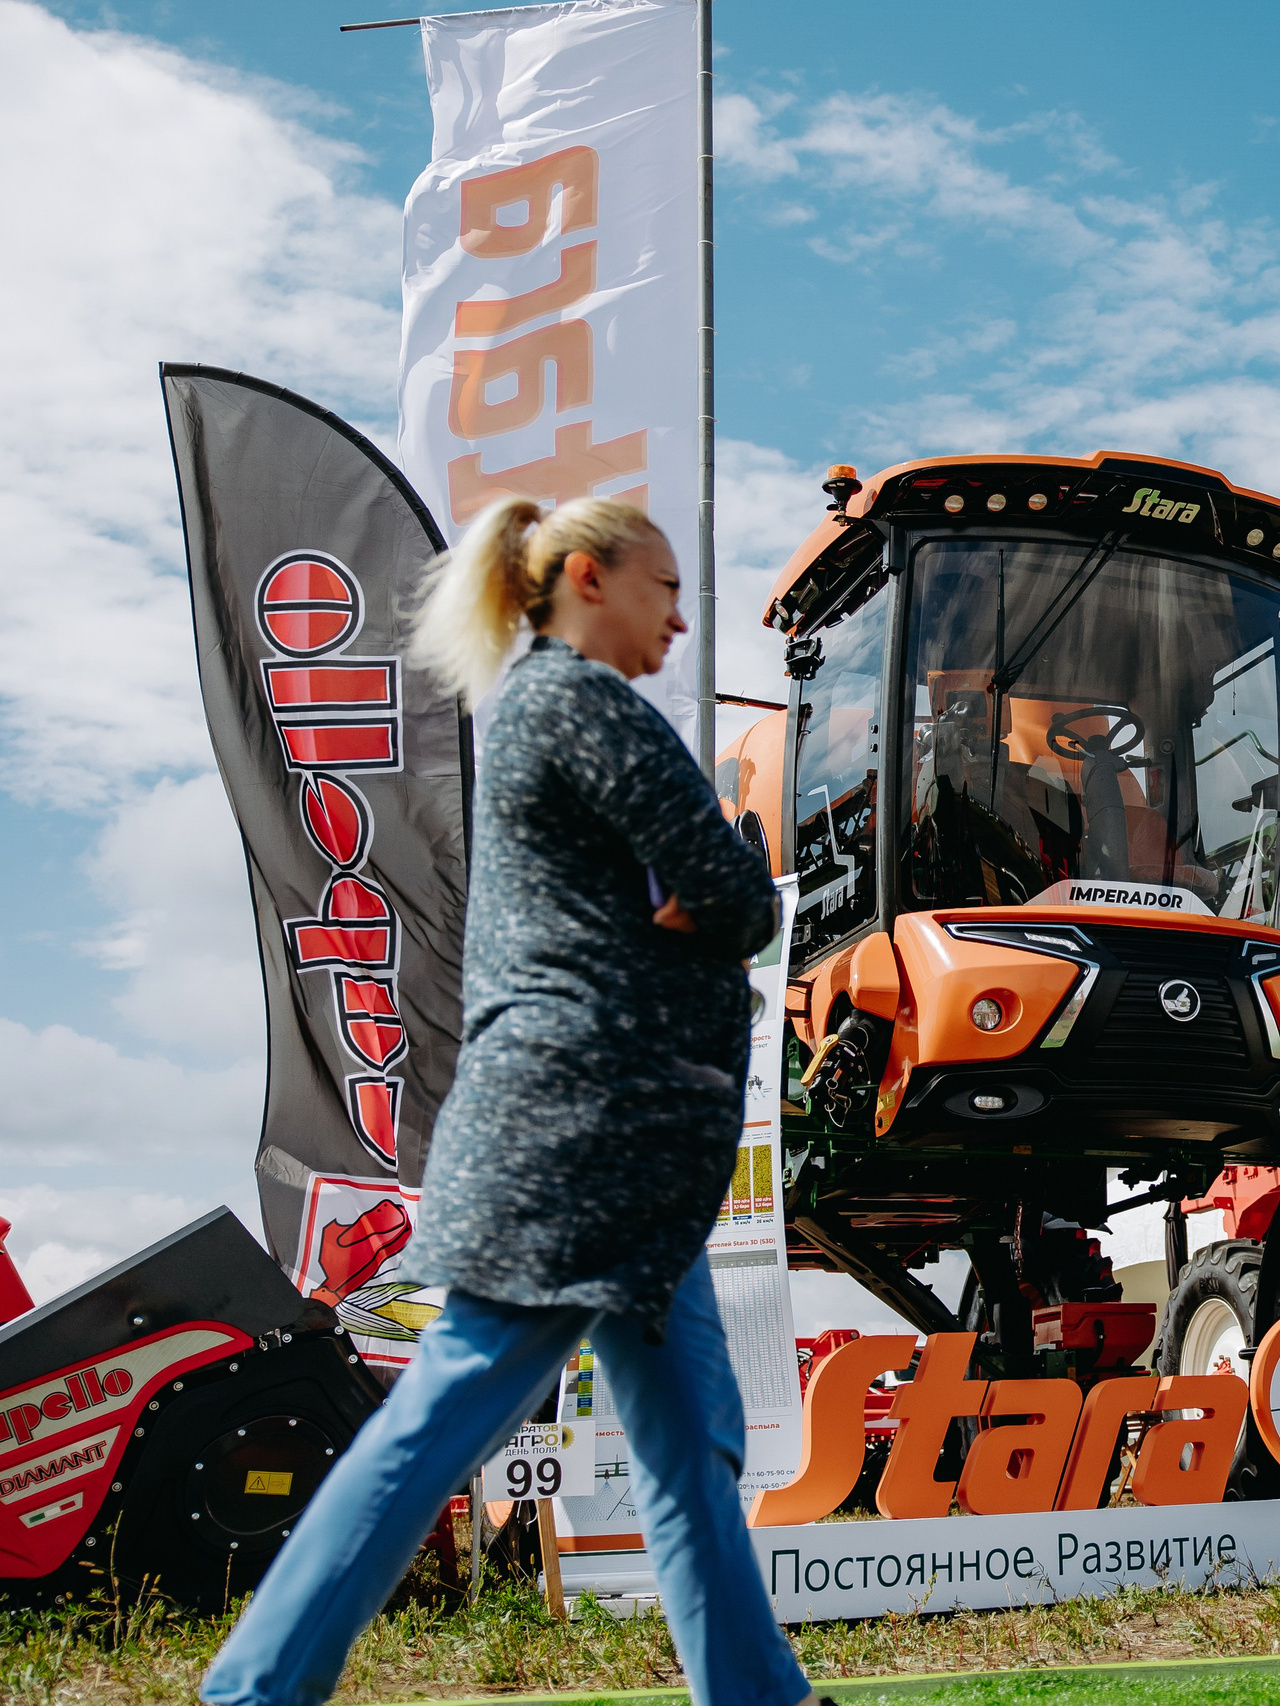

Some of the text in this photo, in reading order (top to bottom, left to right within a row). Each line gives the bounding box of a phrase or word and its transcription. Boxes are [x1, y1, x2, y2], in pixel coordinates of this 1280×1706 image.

[1121, 487, 1201, 524] Stara
[820, 885, 845, 921] Stara
[1069, 886, 1184, 909] IMPERADOR
[706, 1240, 732, 1249] лителей
[760, 1237, 776, 1246] (S3D)
[518, 1425, 559, 1434] РАТОВ
[746, 1331, 1249, 1527] Stara
[0, 1440, 107, 1499] DIAMANT
[505, 1446, 558, 1457] ДЕНЬ ПОЛЯ
[506, 1457, 562, 1498] 99
[756, 1469, 785, 1478] 60-75-90
[770, 1532, 1238, 1596] Постоянное Развитие
